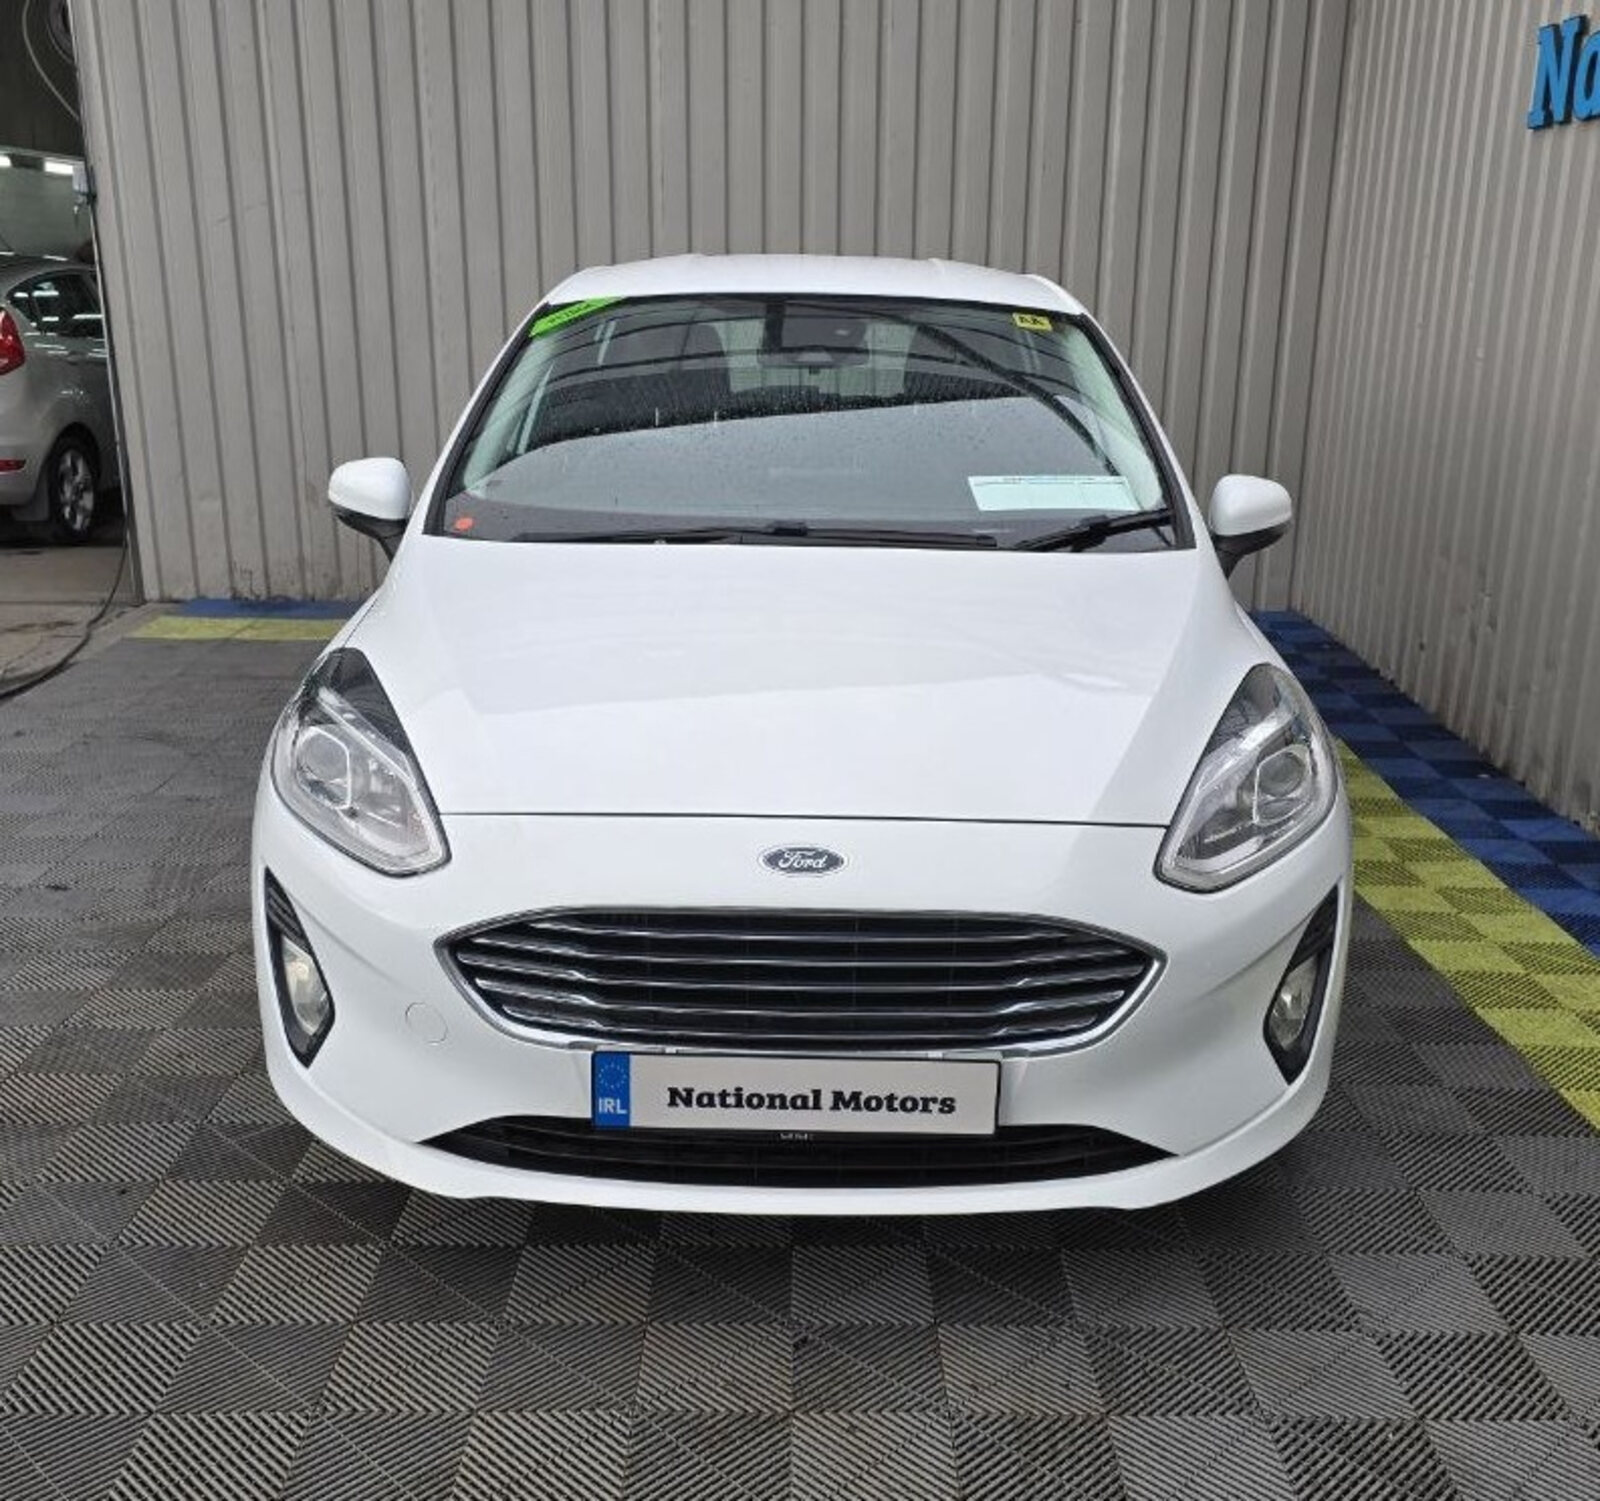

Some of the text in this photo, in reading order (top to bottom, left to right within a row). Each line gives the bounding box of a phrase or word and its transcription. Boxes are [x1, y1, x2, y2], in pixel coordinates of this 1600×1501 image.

[777, 850, 828, 869] Ford
[599, 1098, 627, 1115] IRL
[667, 1087, 956, 1114] National Motors
